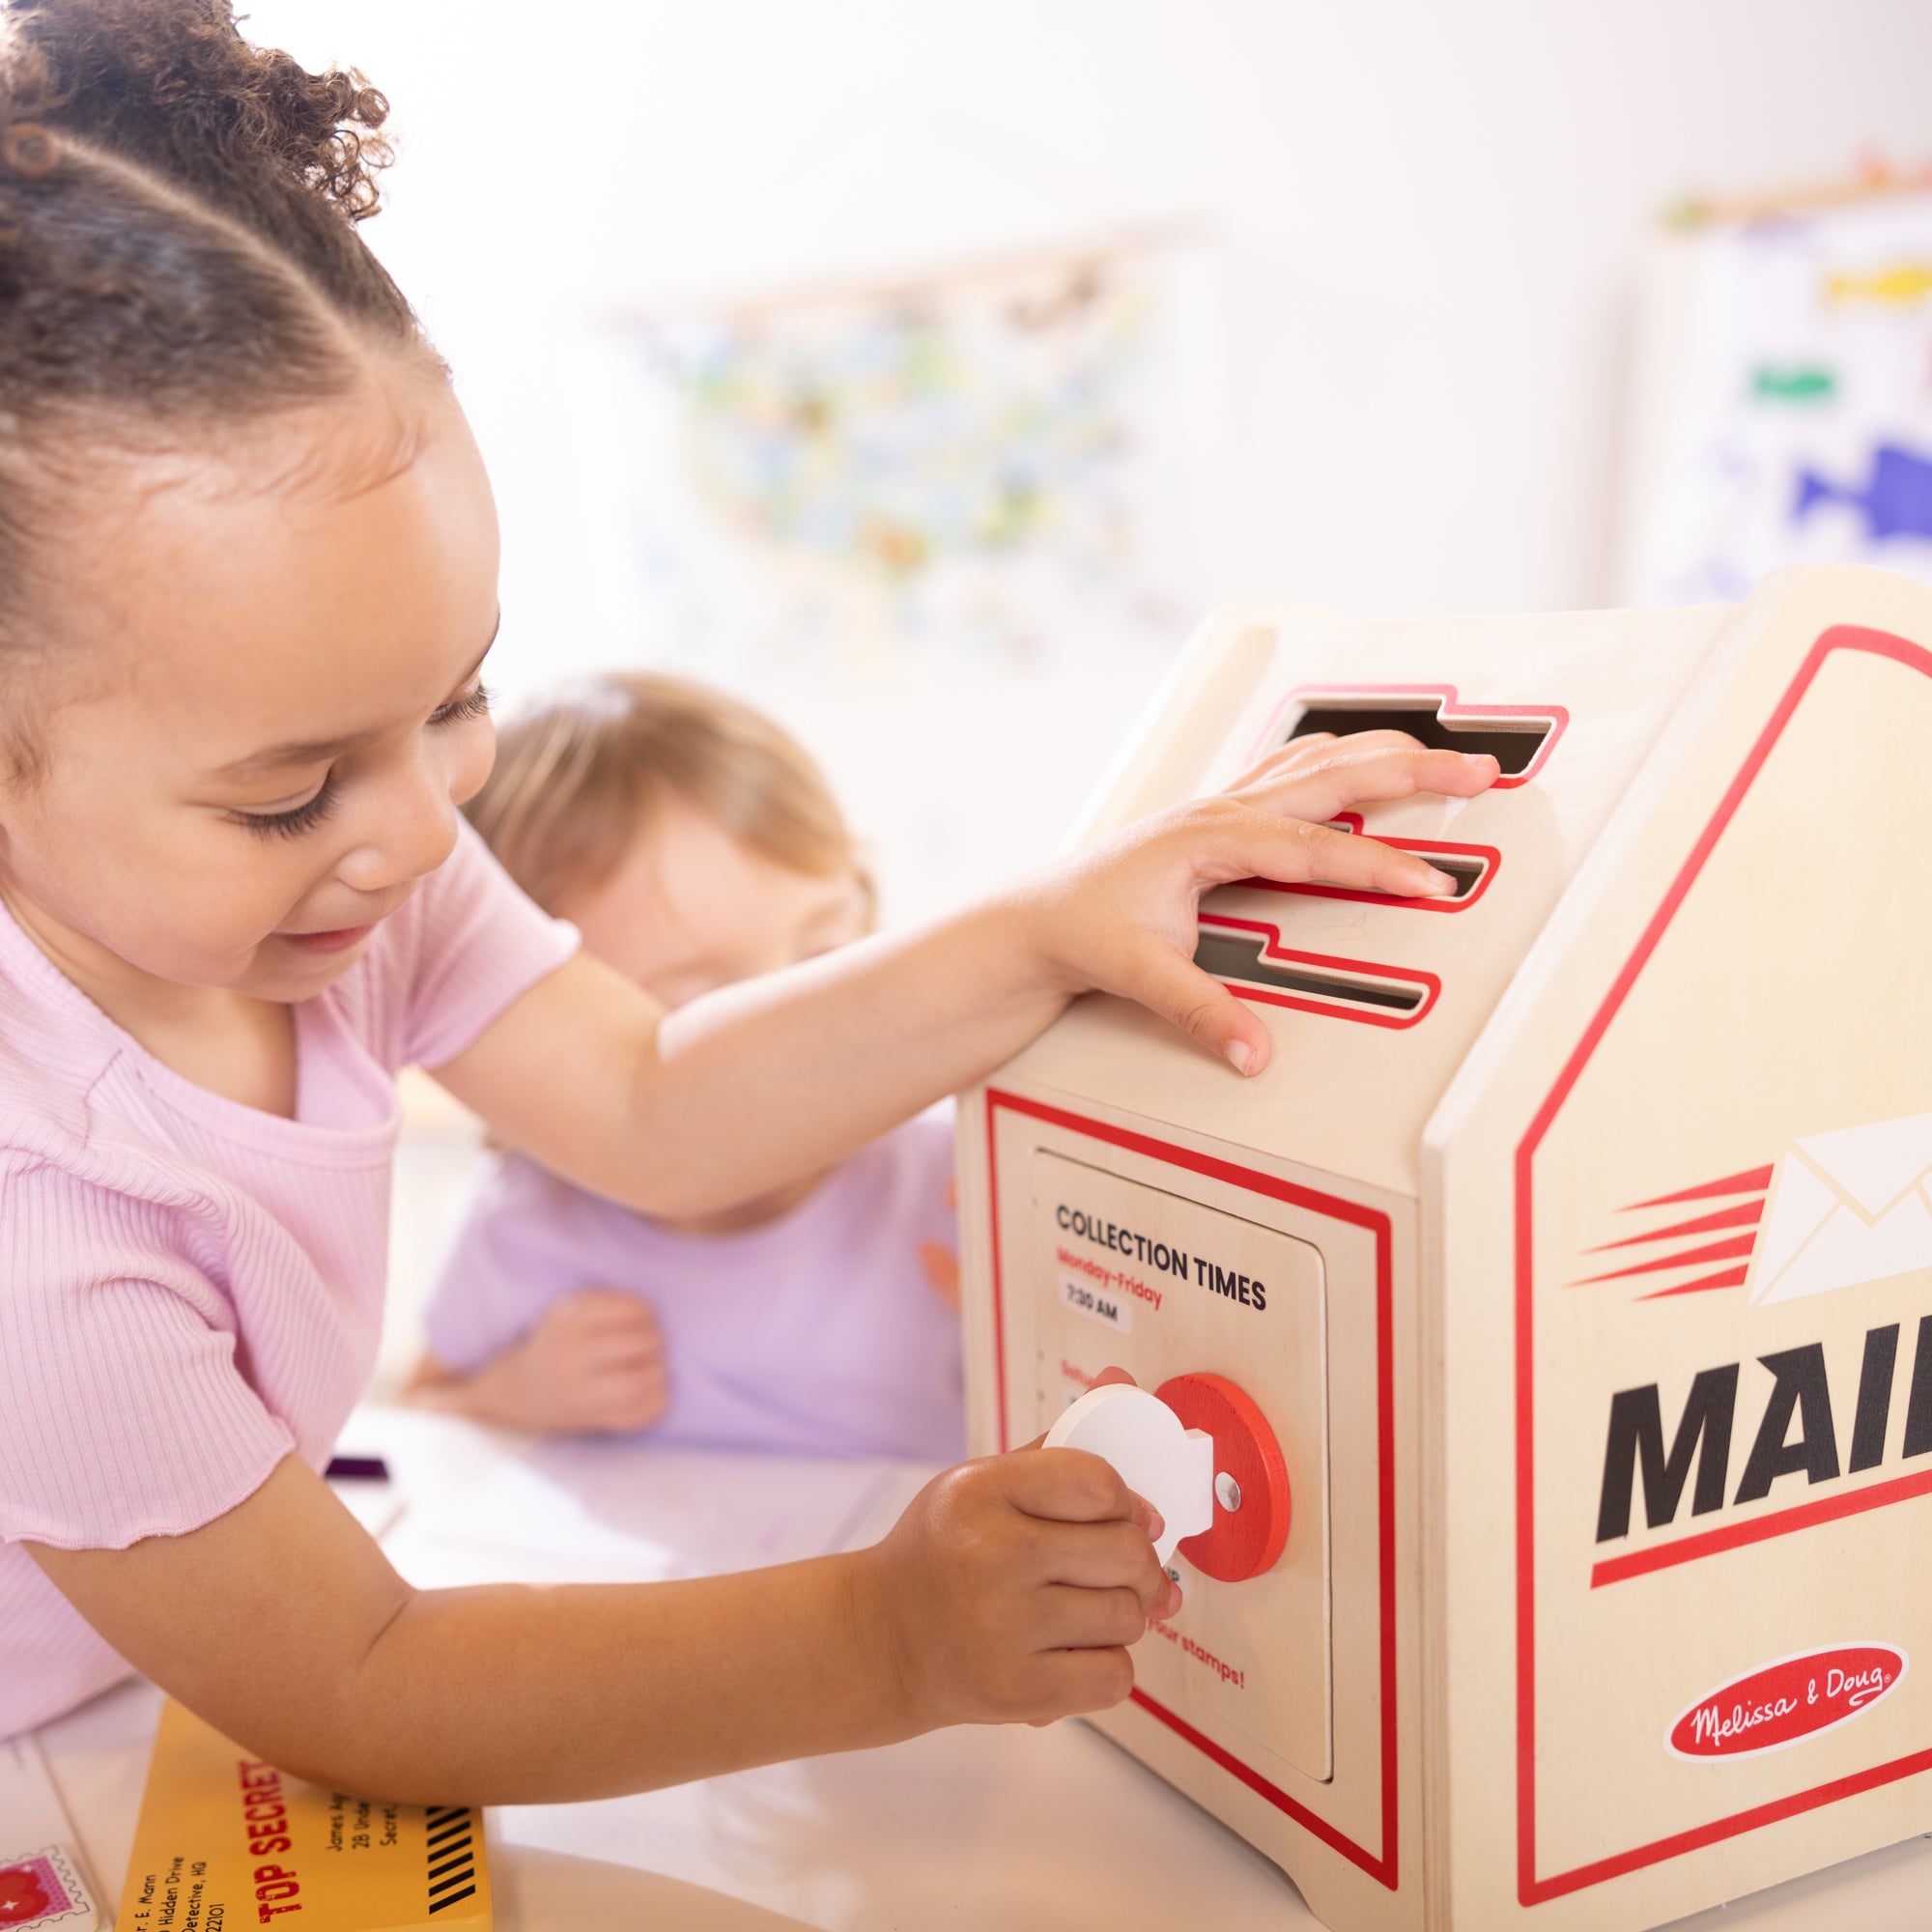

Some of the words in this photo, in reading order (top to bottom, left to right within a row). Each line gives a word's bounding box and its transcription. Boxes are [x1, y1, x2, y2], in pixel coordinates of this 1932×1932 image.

[1056, 1205, 1188, 1281] COLLECTION
[1193, 1257, 1266, 1311] TIMES
[1057, 1246, 1162, 1311] Monday-Friday
[1096, 1299, 1118, 1321] AM
[1181, 1636, 1245, 1690] stamps!
[1690, 1697, 1798, 1747] Melissa
[1806, 1679, 1819, 1705] &
[238, 1760, 292, 1856] SECRET
[327, 1814, 344, 1852] James
[165, 1857, 185, 1884] Drive
[191, 1861, 207, 1876] HQ
[138, 1874, 156, 1904] Mann
[157, 1887, 179, 1925] Hidden
[254, 1864, 302, 1924] TOP
[134, 1909, 151, 1918] E.
